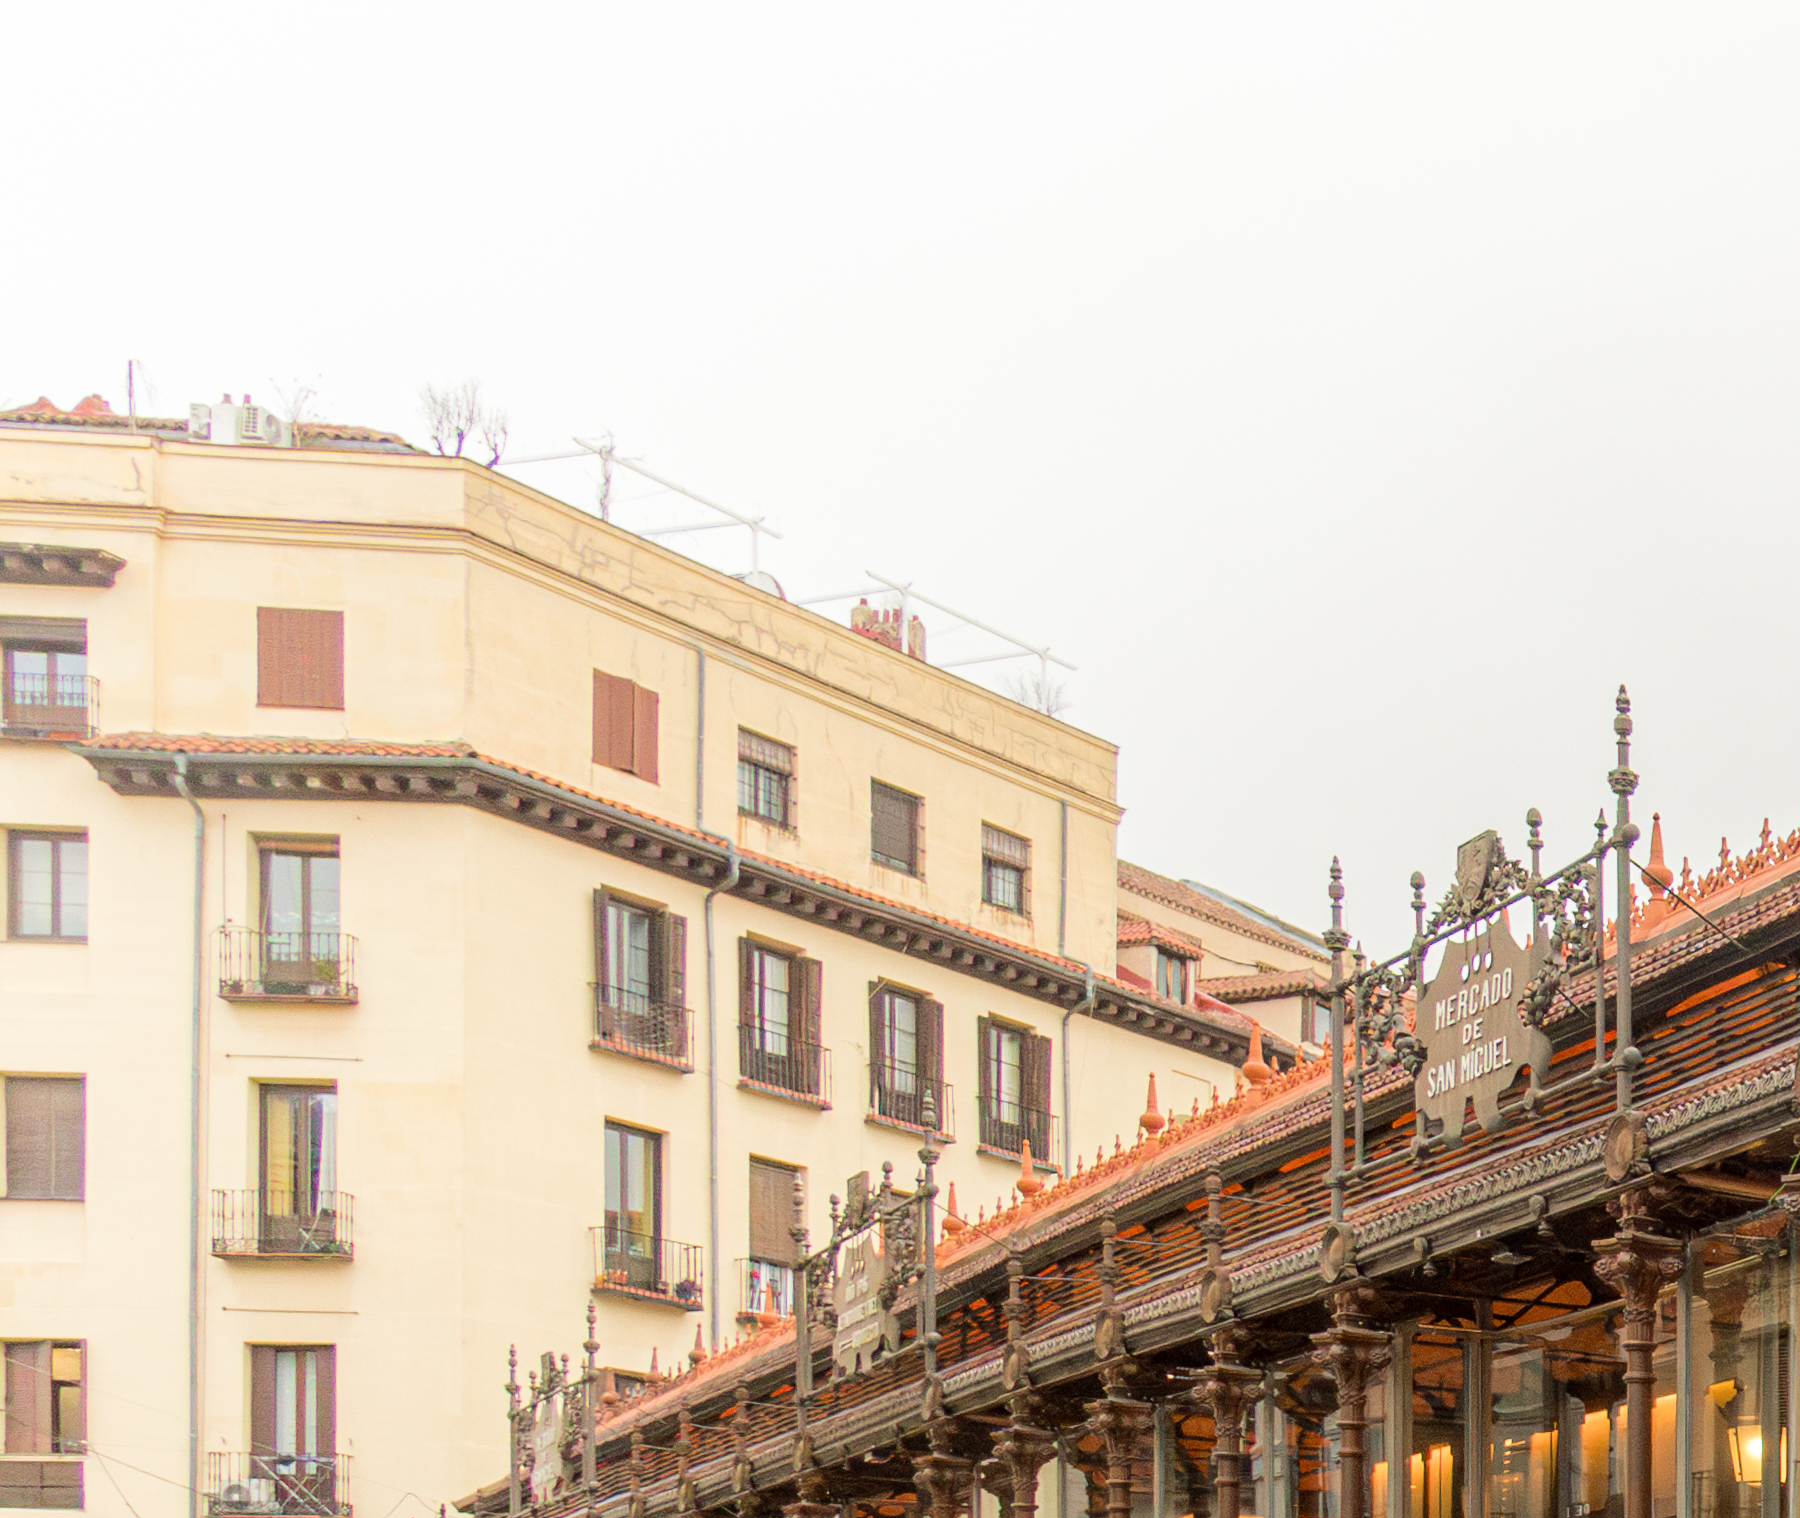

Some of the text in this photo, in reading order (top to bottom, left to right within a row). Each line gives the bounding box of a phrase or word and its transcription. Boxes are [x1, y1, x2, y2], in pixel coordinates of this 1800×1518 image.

[1435, 967, 1513, 1031] MERCADO
[1462, 1018, 1483, 1045] DE
[1427, 1059, 1456, 1098] SAN
